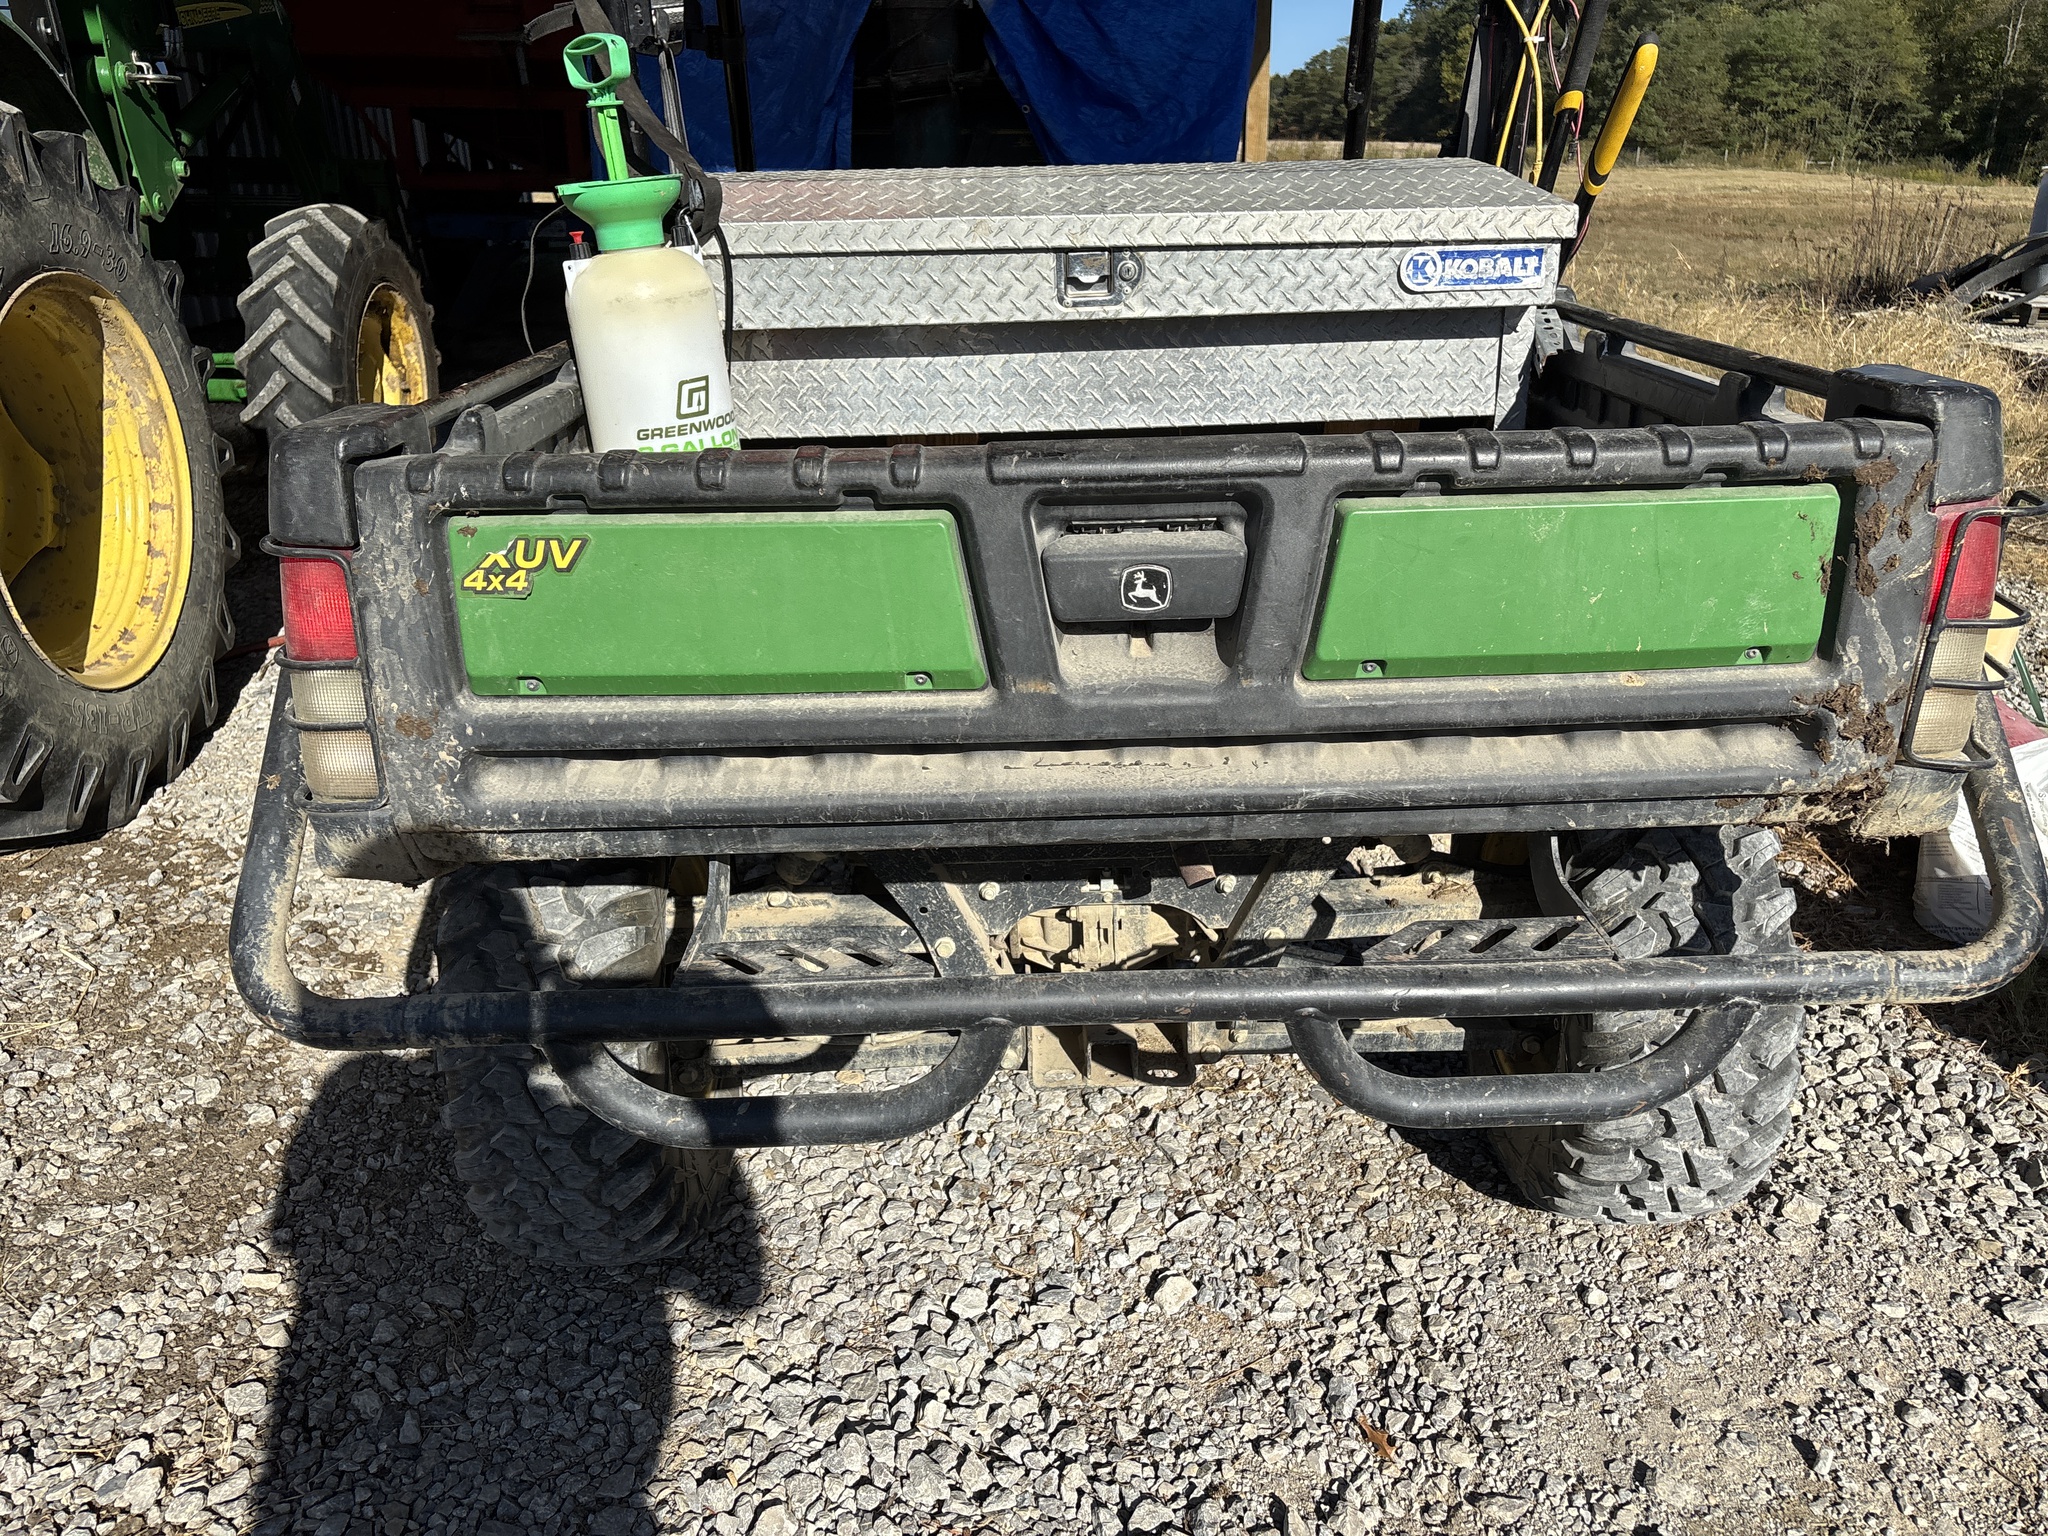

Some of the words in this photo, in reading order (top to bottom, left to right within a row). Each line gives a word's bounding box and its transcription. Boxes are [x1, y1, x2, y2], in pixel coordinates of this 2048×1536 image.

[49, 222, 128, 282] 16.9-30
[1443, 255, 1540, 280] KOBALT
[463, 569, 529, 591] 4x4
